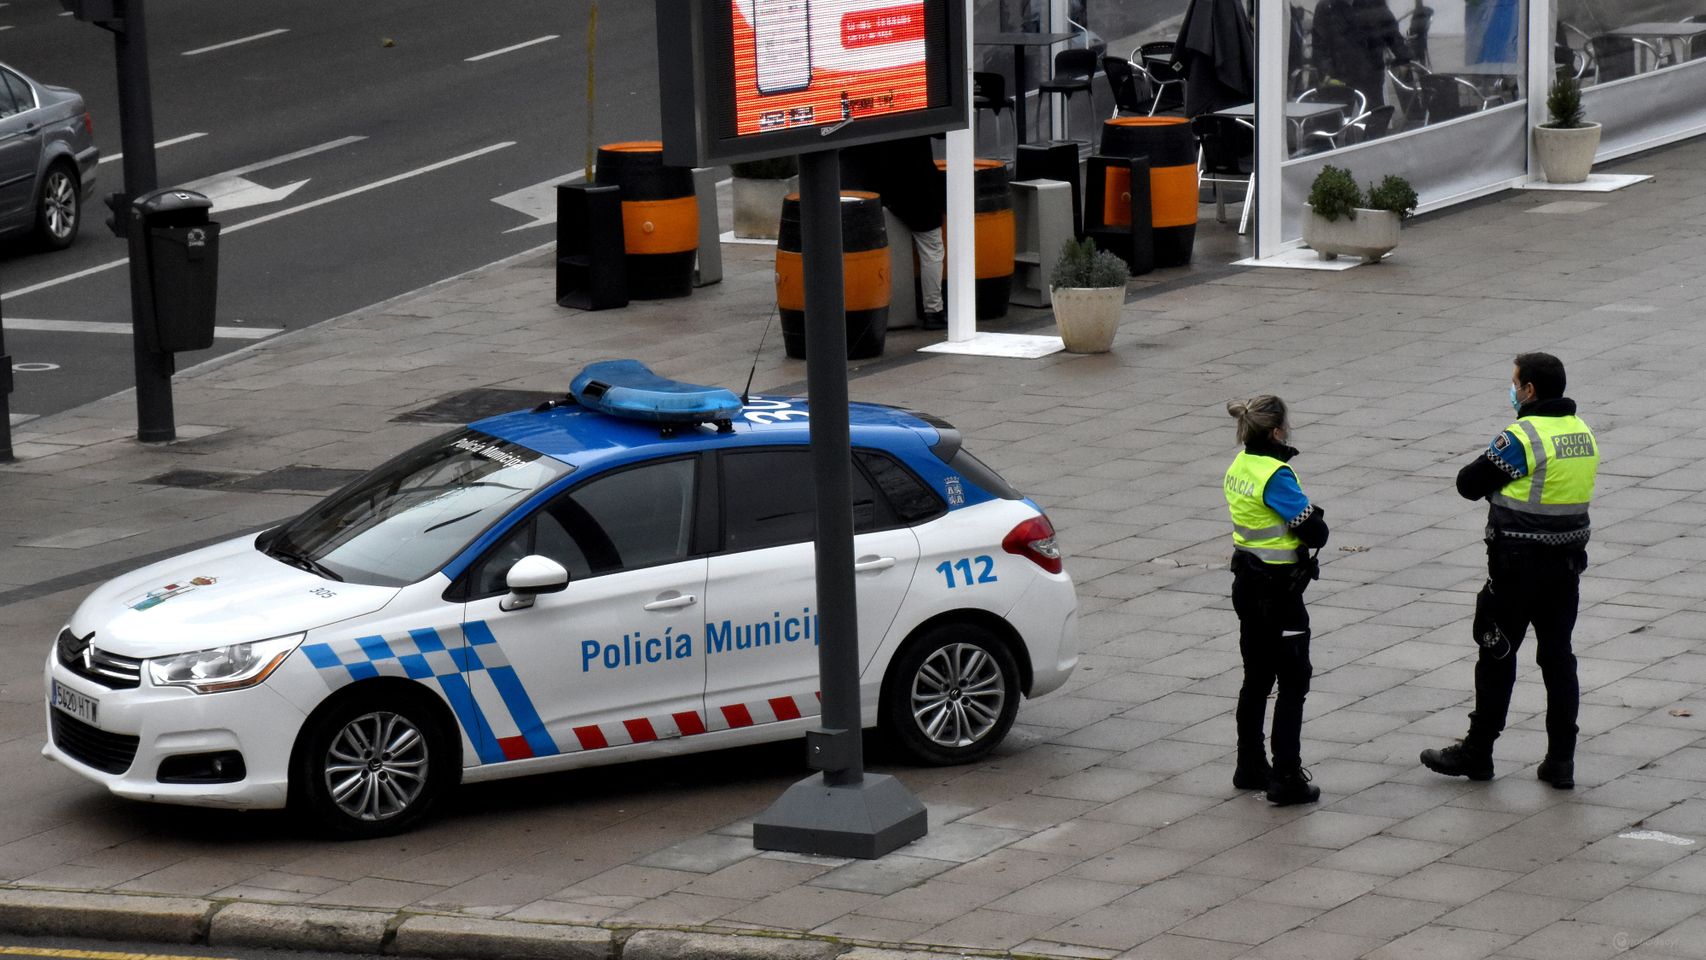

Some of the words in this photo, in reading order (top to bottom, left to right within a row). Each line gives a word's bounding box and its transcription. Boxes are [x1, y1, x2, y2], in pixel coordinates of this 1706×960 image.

[1561, 445, 1590, 457] LOCAL
[936, 555, 997, 589] 112
[309, 587, 337, 598] 305
[581, 627, 692, 673] Policía
